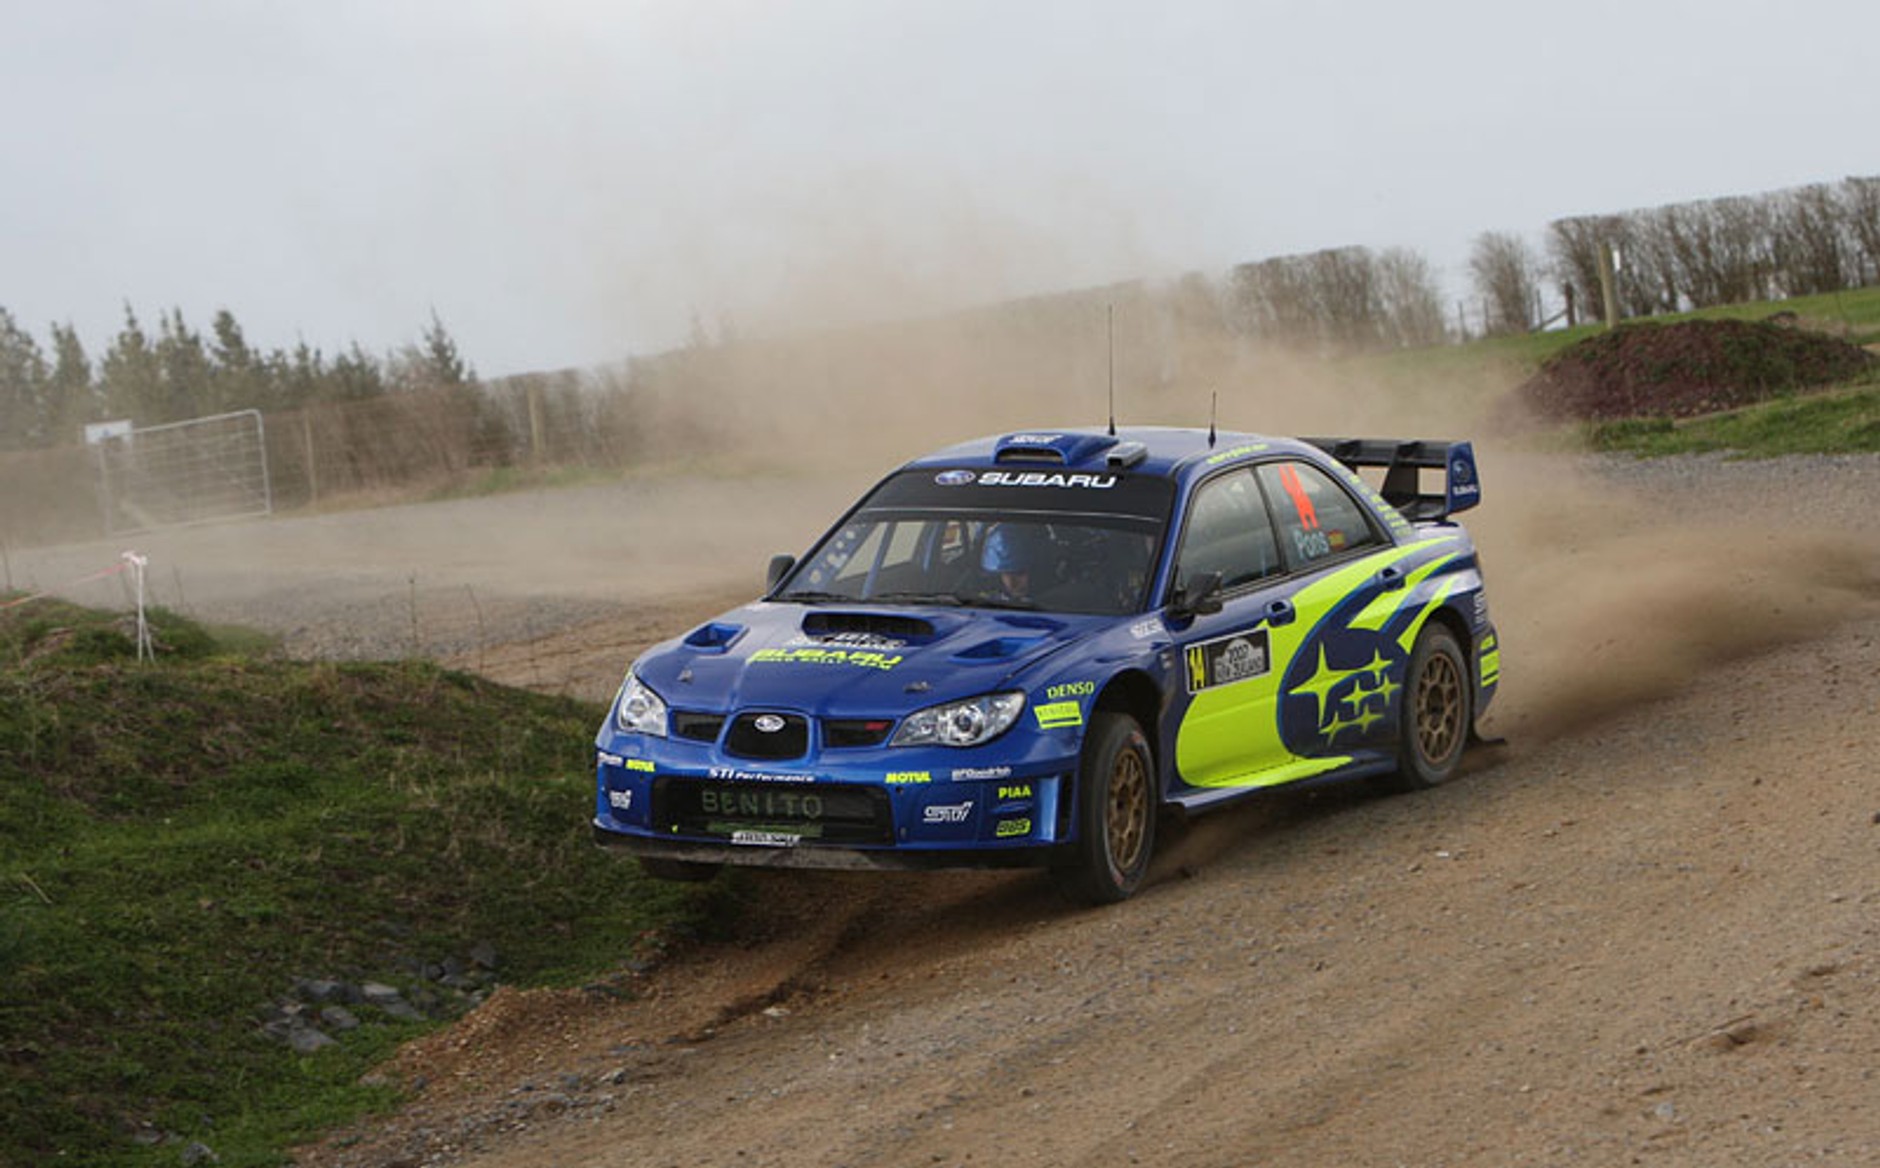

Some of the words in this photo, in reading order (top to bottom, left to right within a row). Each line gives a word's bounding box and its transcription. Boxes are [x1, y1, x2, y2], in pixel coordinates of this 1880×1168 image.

[978, 472, 1117, 488] SUBARU
[746, 648, 903, 667] SUBARU
[1046, 680, 1095, 699] DENSO
[709, 767, 733, 779] STI
[885, 771, 932, 783] MOTUL
[998, 785, 1032, 799] PIAA
[702, 790, 824, 819] BENITO
